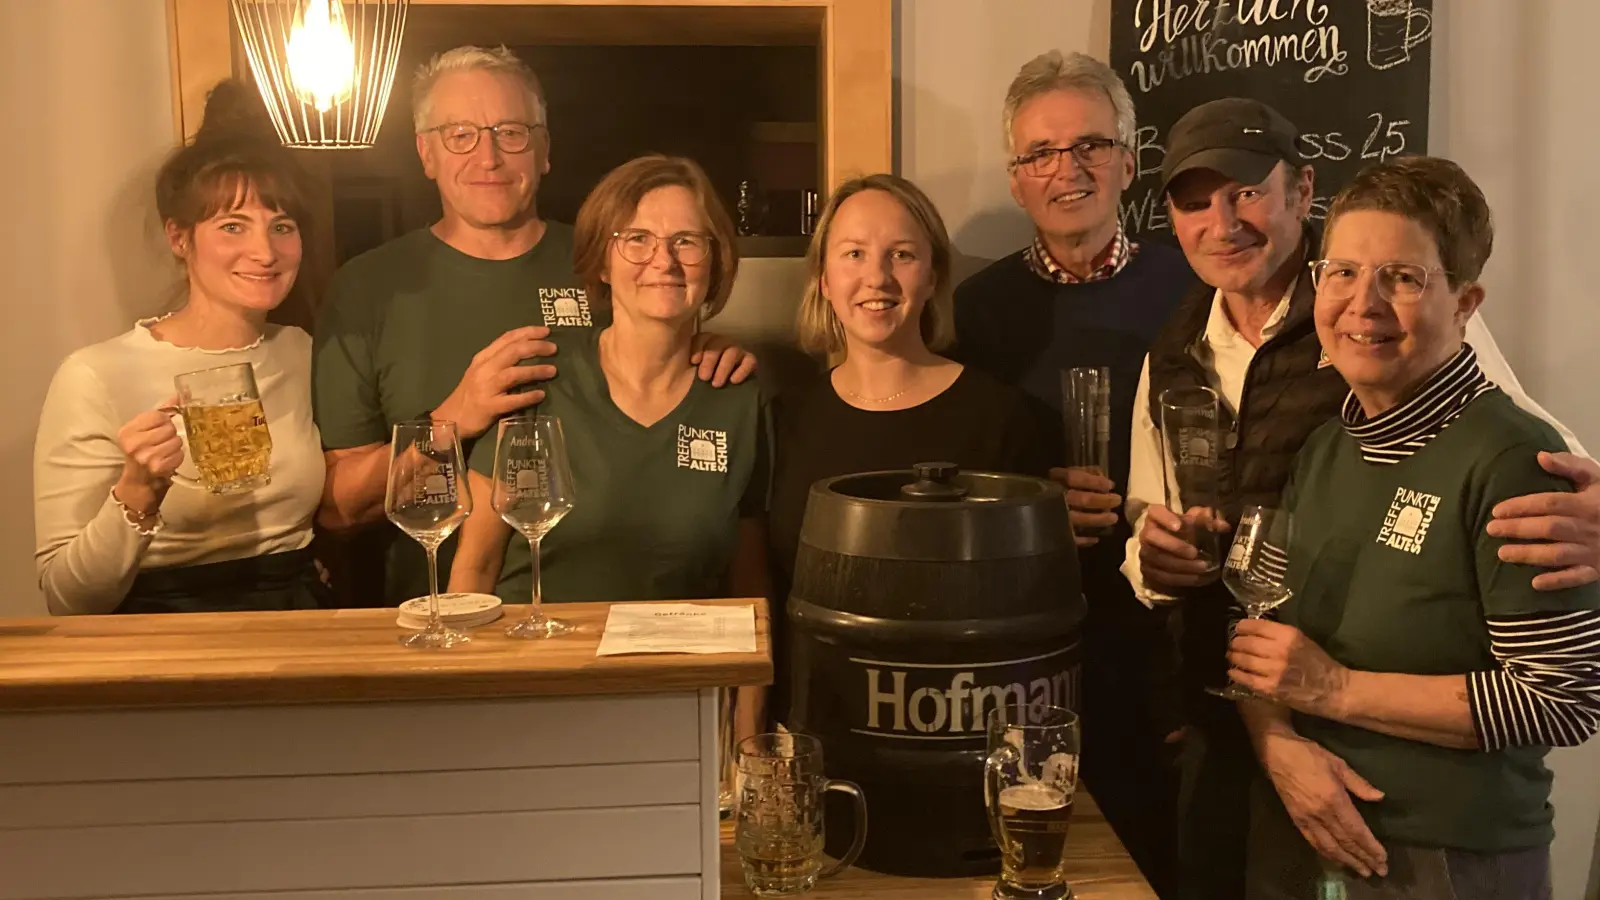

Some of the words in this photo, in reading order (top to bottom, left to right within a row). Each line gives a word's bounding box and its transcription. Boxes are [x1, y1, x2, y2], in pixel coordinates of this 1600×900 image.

[1135, 0, 1328, 52] Herzlich
[1299, 132, 1352, 161] SS
[1361, 112, 1410, 163] 2,5
[538, 288, 576, 298] PUNKT
[576, 289, 593, 327] SCHULE
[540, 297, 556, 327] TREFF
[557, 317, 582, 327] ALTE
[678, 424, 716, 440] PUNKT
[507, 459, 536, 470] PUNKT
[677, 432, 691, 468] TREFF
[715, 431, 728, 473] SCHULE
[690, 460, 717, 472] ALTE
[446, 463, 458, 502] SCHULE
[1394, 487, 1432, 508] PUNKT
[426, 494, 448, 504] ALTE
[1376, 501, 1402, 543] TREFF
[1410, 495, 1441, 555] SCHULE
[1386, 533, 1413, 552] ALTE
